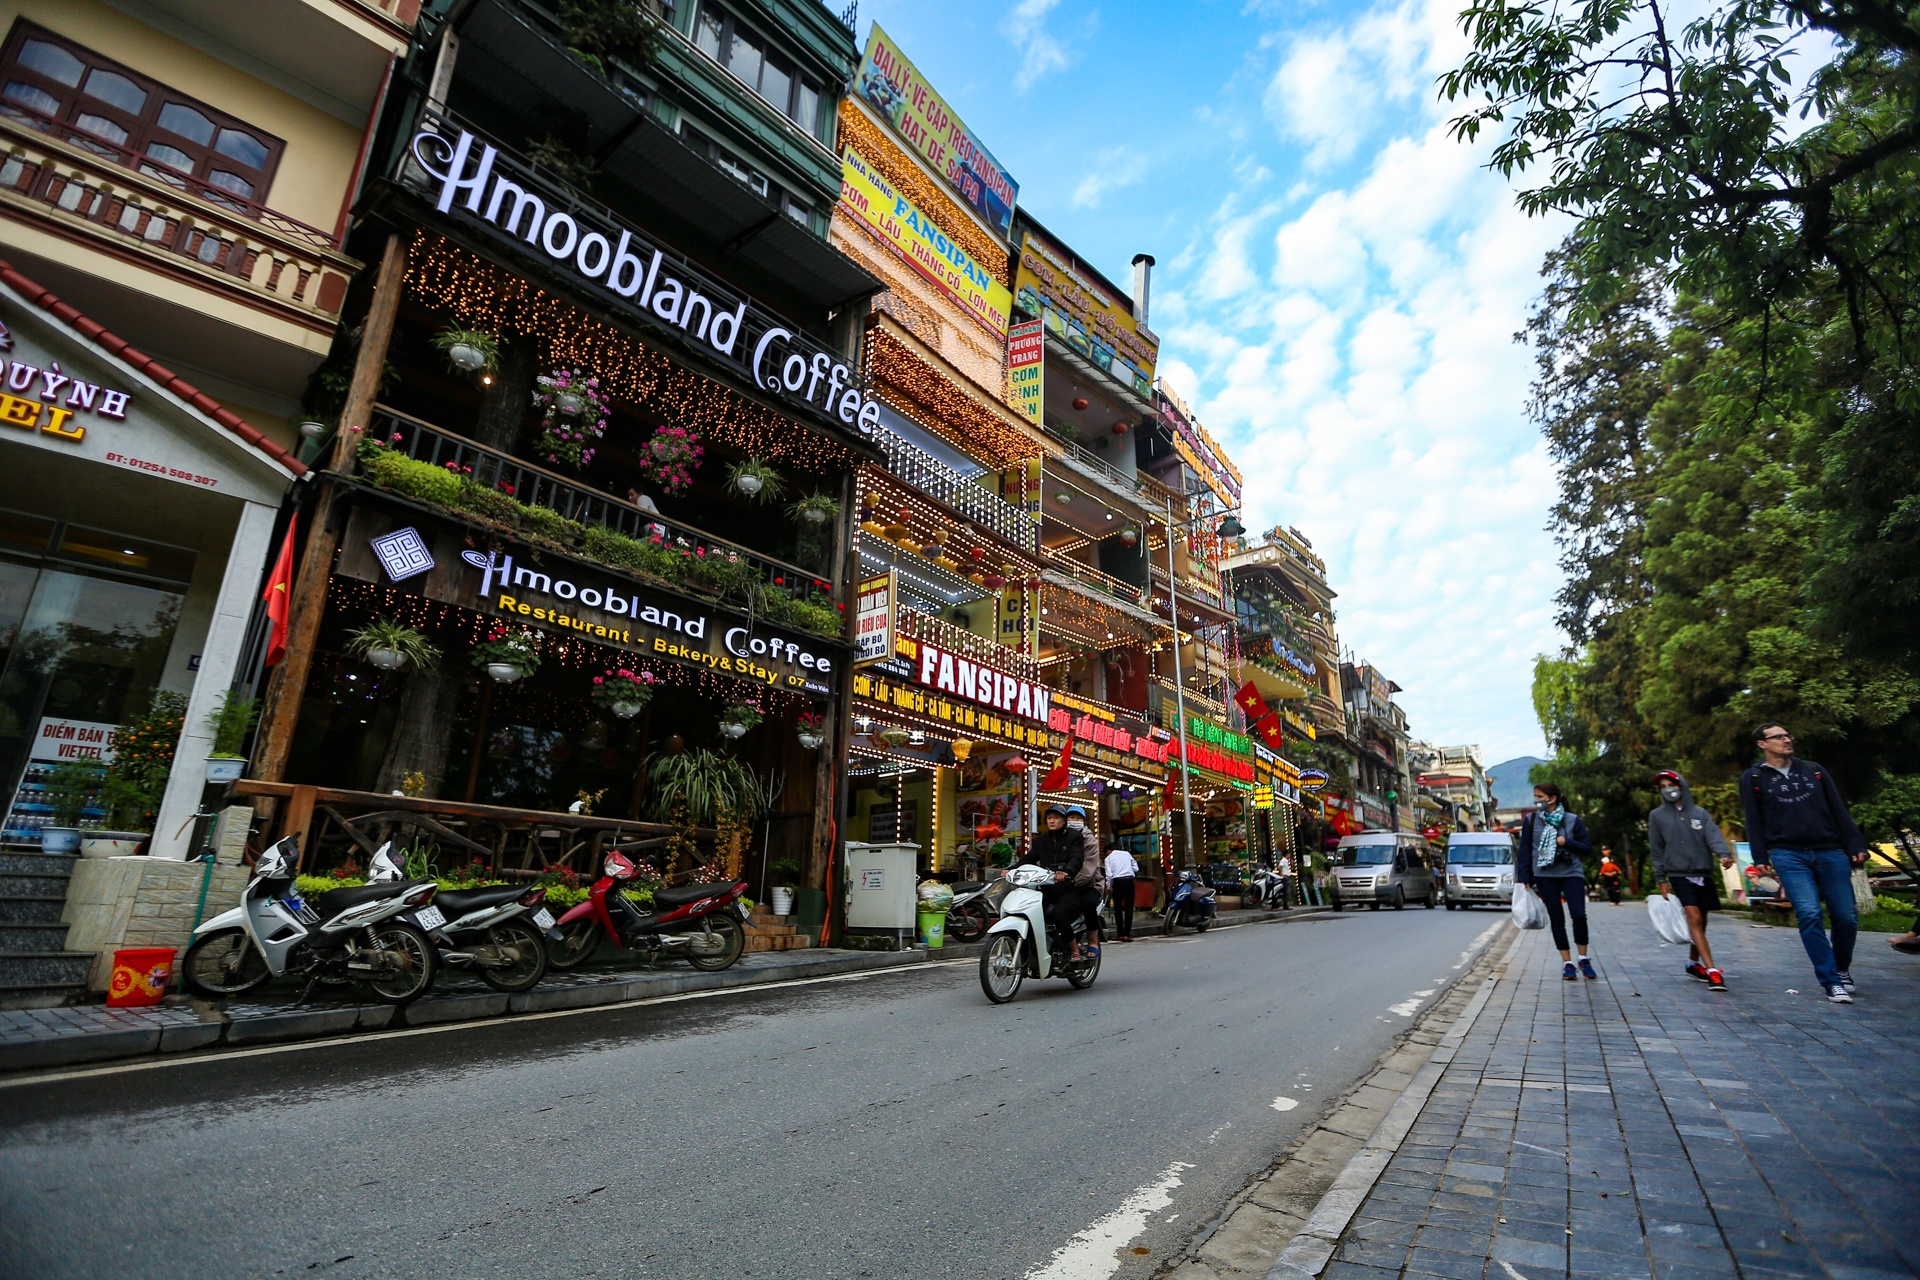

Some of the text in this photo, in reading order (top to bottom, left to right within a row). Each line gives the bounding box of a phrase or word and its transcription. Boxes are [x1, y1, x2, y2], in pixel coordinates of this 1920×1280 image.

[926, 99, 948, 134] CÁP
[947, 121, 973, 161] TREO
[971, 146, 1016, 208] FANSIPAN
[841, 179, 870, 214] CƠM
[878, 213, 902, 240] LẨU
[946, 272, 962, 291] CỐ
[868, 171, 894, 200] HÀNG
[894, 196, 990, 292] FANSIPAN
[410, 128, 881, 434] Hmoobland Coffee
[1022, 252, 1056, 287] CƠM
[1096, 310, 1116, 332] ĐỒ
[1116, 325, 1157, 366] NƯỚNG
[1009, 336, 1041, 351] PHƯƠNG
[1012, 350, 1038, 364] TRANG
[1012, 367, 1038, 383] CƠM
[106, 452, 218, 487] ĐT: 01254 508 307
[461, 548, 832, 673] Hmoobland Coffee
[860, 588, 888, 612] XUÂN VIÊN
[499, 595, 631, 644] Restaurant
[788, 675, 806, 687] 07
[861, 615, 874, 634] RIÊU
[875, 613, 887, 631] CUA
[853, 675, 870, 697] CƠM
[875, 676, 888, 703] LẨU
[893, 683, 914, 710] THẮNG
[915, 689, 924, 713] CỐ
[928, 696, 938, 716] CÁ
[938, 696, 951, 720] TẦM
[955, 704, 964, 724] CÁ
[920, 645, 1049, 723] FANSIPAN
[42, 720, 76, 740] ĐIỂM
[77, 726, 104, 743] BÁN
[1048, 707, 1071, 734] CƠM
[58, 743, 102, 760] VIETTEL
